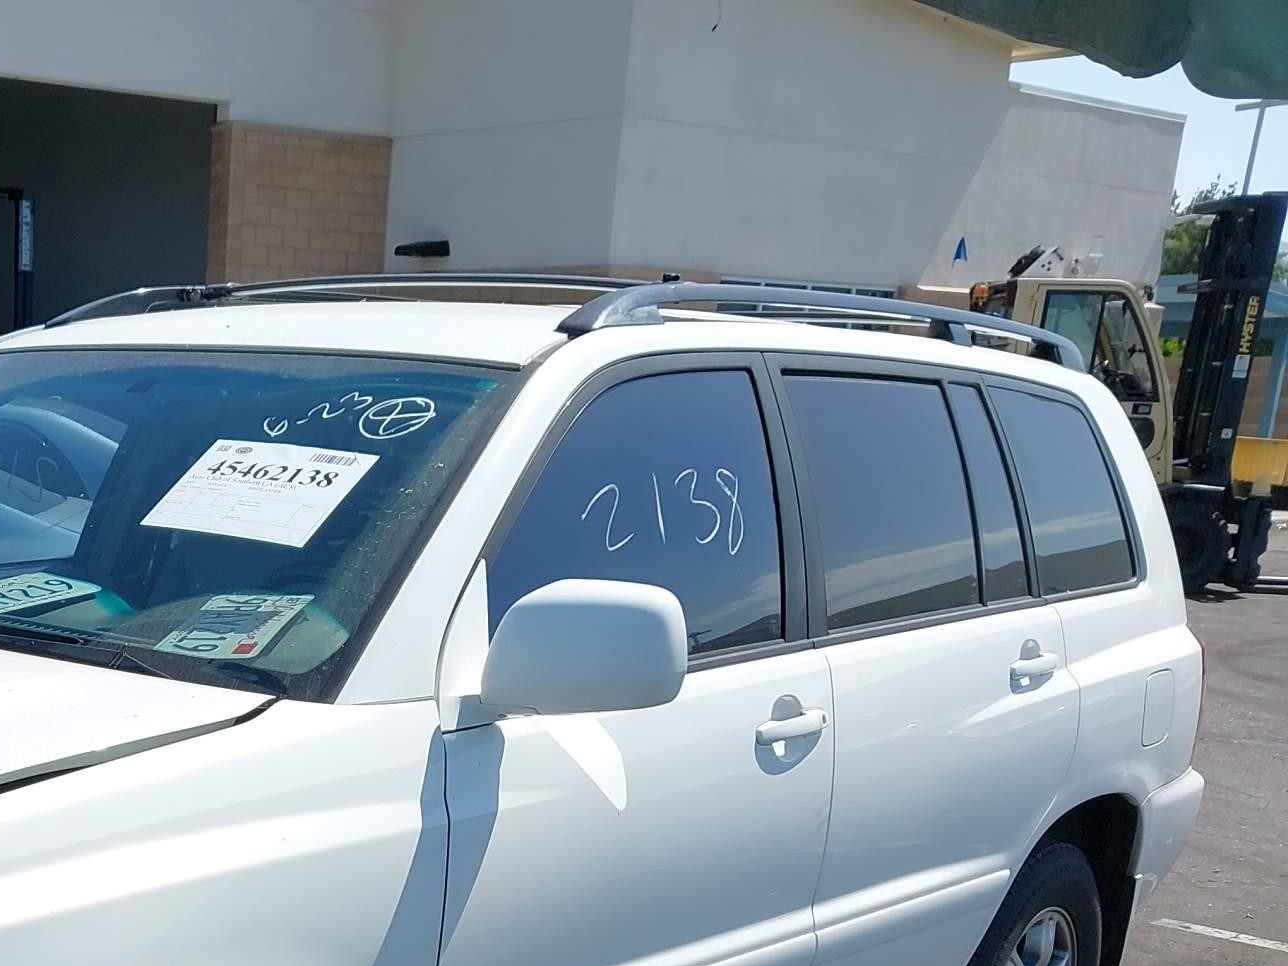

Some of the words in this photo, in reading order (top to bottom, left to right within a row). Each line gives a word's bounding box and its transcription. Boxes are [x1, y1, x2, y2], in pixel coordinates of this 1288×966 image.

[1239, 295, 1260, 353] HYSTER
[206, 460, 340, 488] 45462138
[581, 468, 744, 555] 2138
